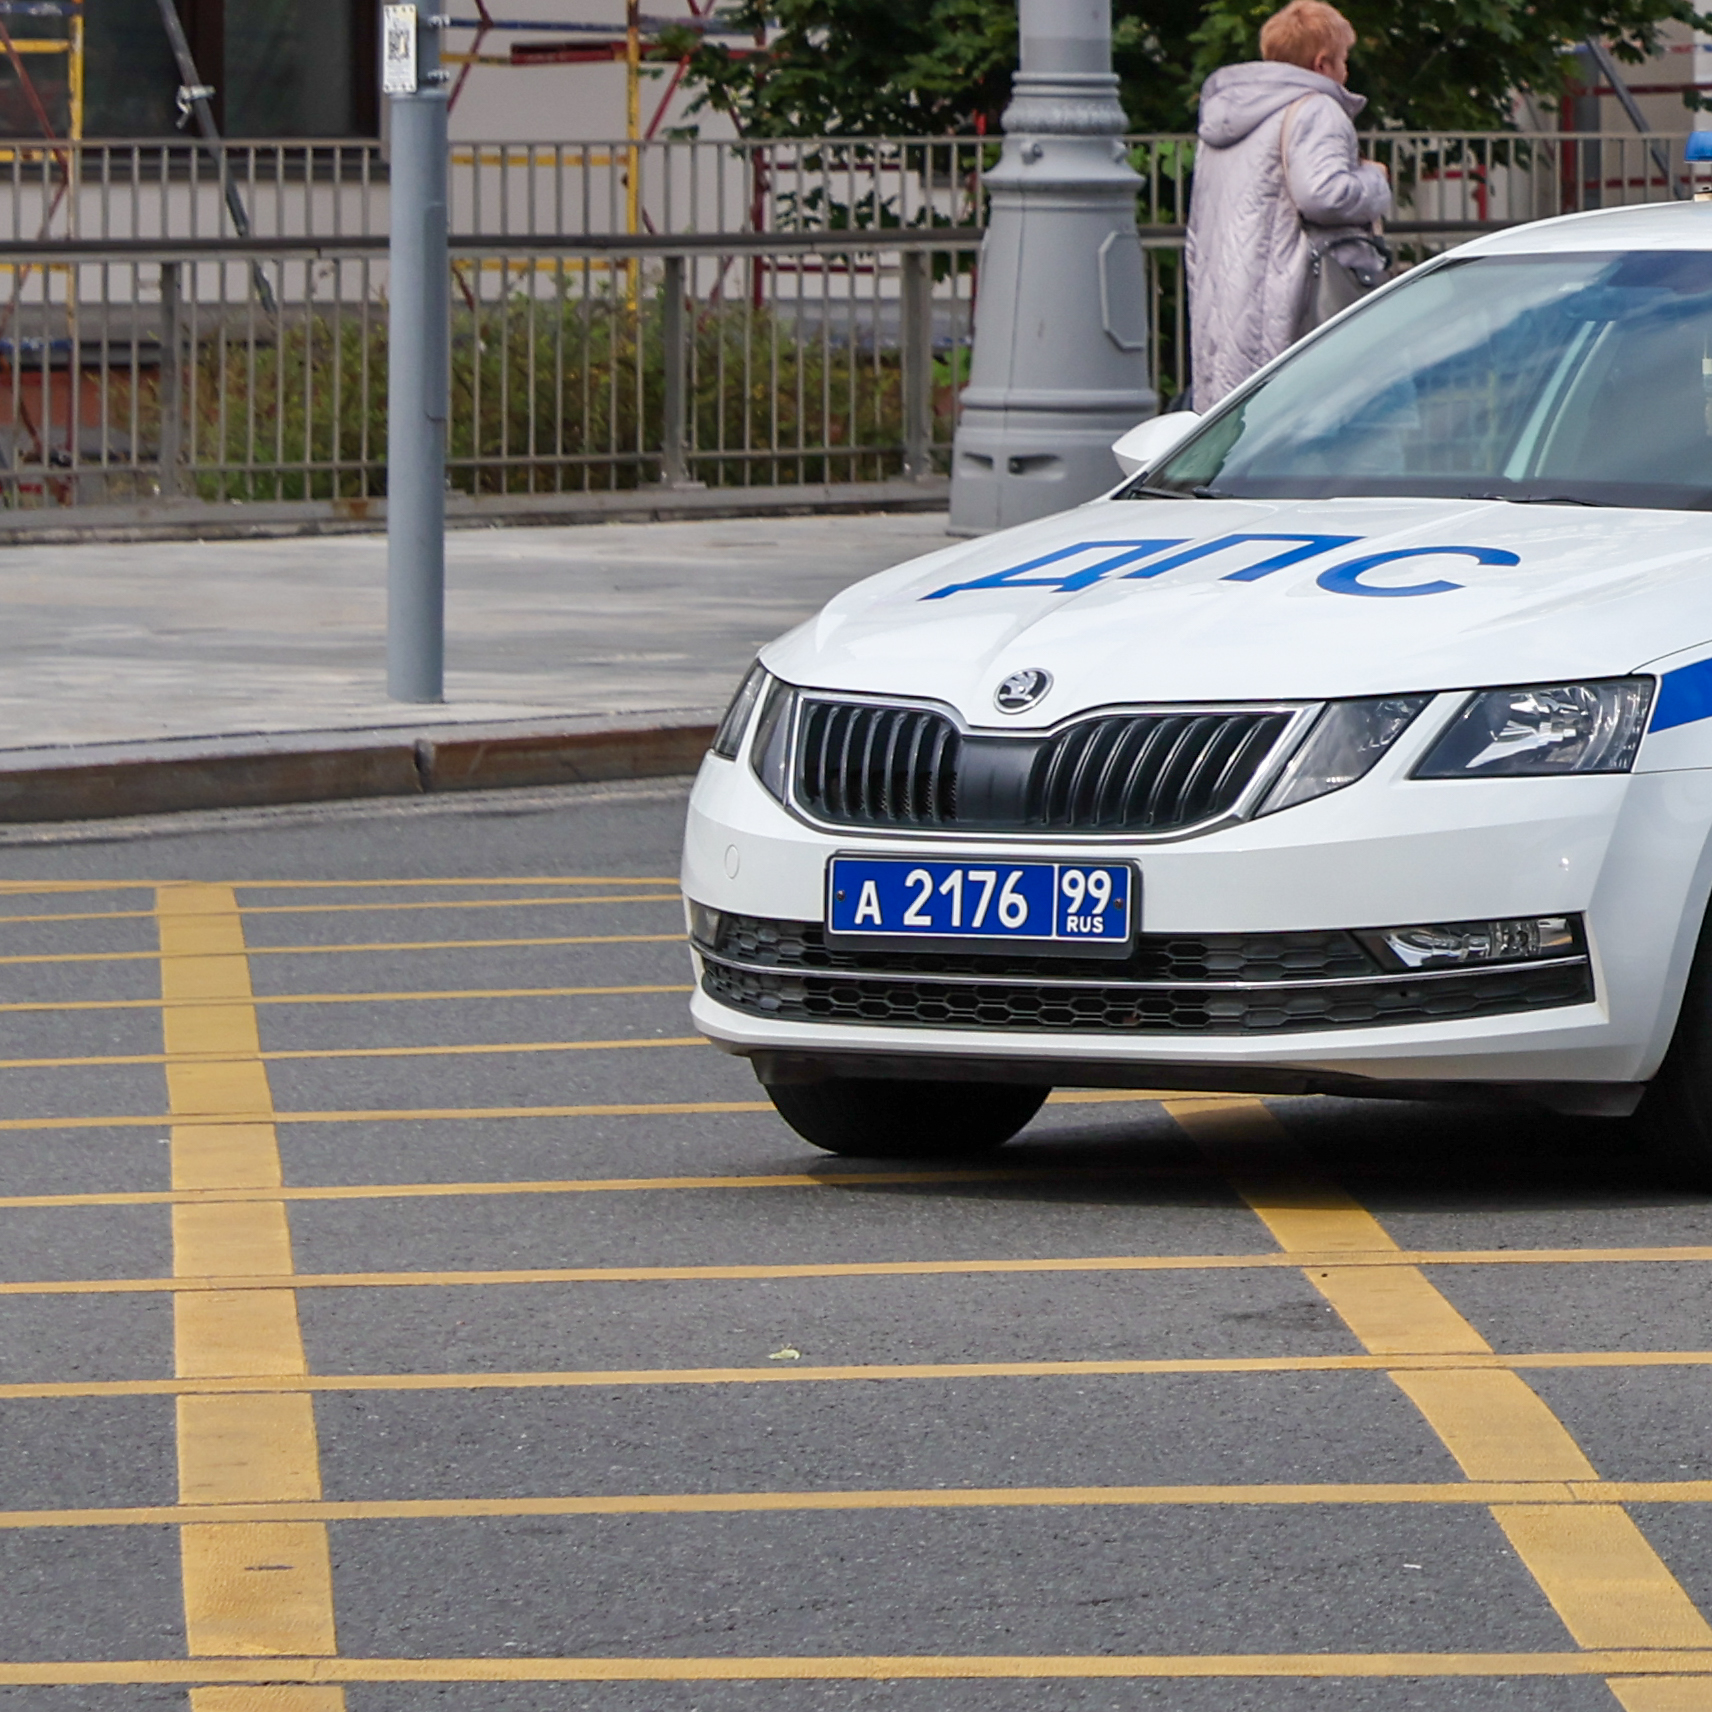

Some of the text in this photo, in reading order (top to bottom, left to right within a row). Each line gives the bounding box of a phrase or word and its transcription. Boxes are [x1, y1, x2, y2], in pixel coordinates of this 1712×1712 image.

[917, 533, 1521, 600] ДПС
[902, 867, 1029, 929] 2176
[1061, 868, 1113, 915] 99
[1066, 915, 1104, 934] RUS
